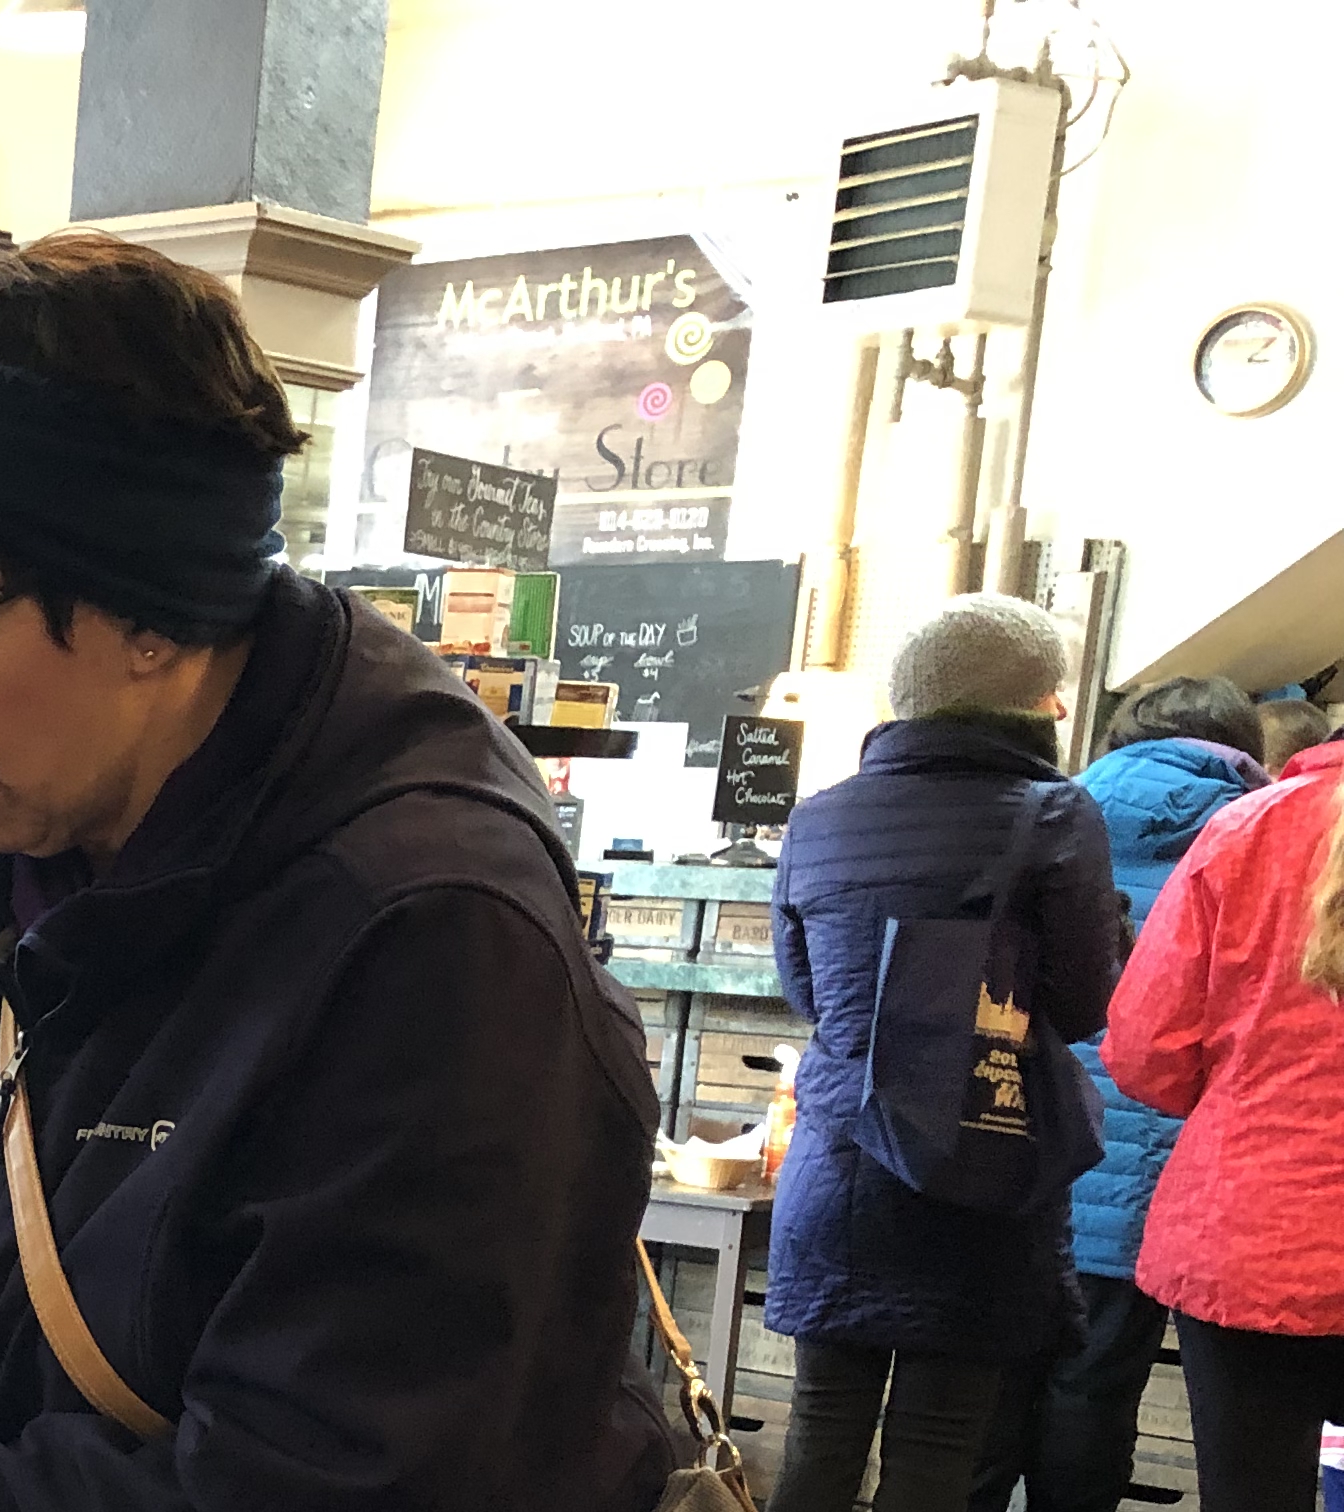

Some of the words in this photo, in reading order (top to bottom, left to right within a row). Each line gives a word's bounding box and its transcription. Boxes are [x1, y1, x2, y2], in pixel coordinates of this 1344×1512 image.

[436, 259, 697, 328] McArthur's
[584, 423, 723, 492] Store
[568, 623, 605, 647] SOUP
[638, 622, 667, 646] DAY
[736, 722, 780, 746] Salted
[742, 747, 790, 766] Caramel
[726, 769, 755, 786] Hot
[735, 786, 792, 806] Chocolate
